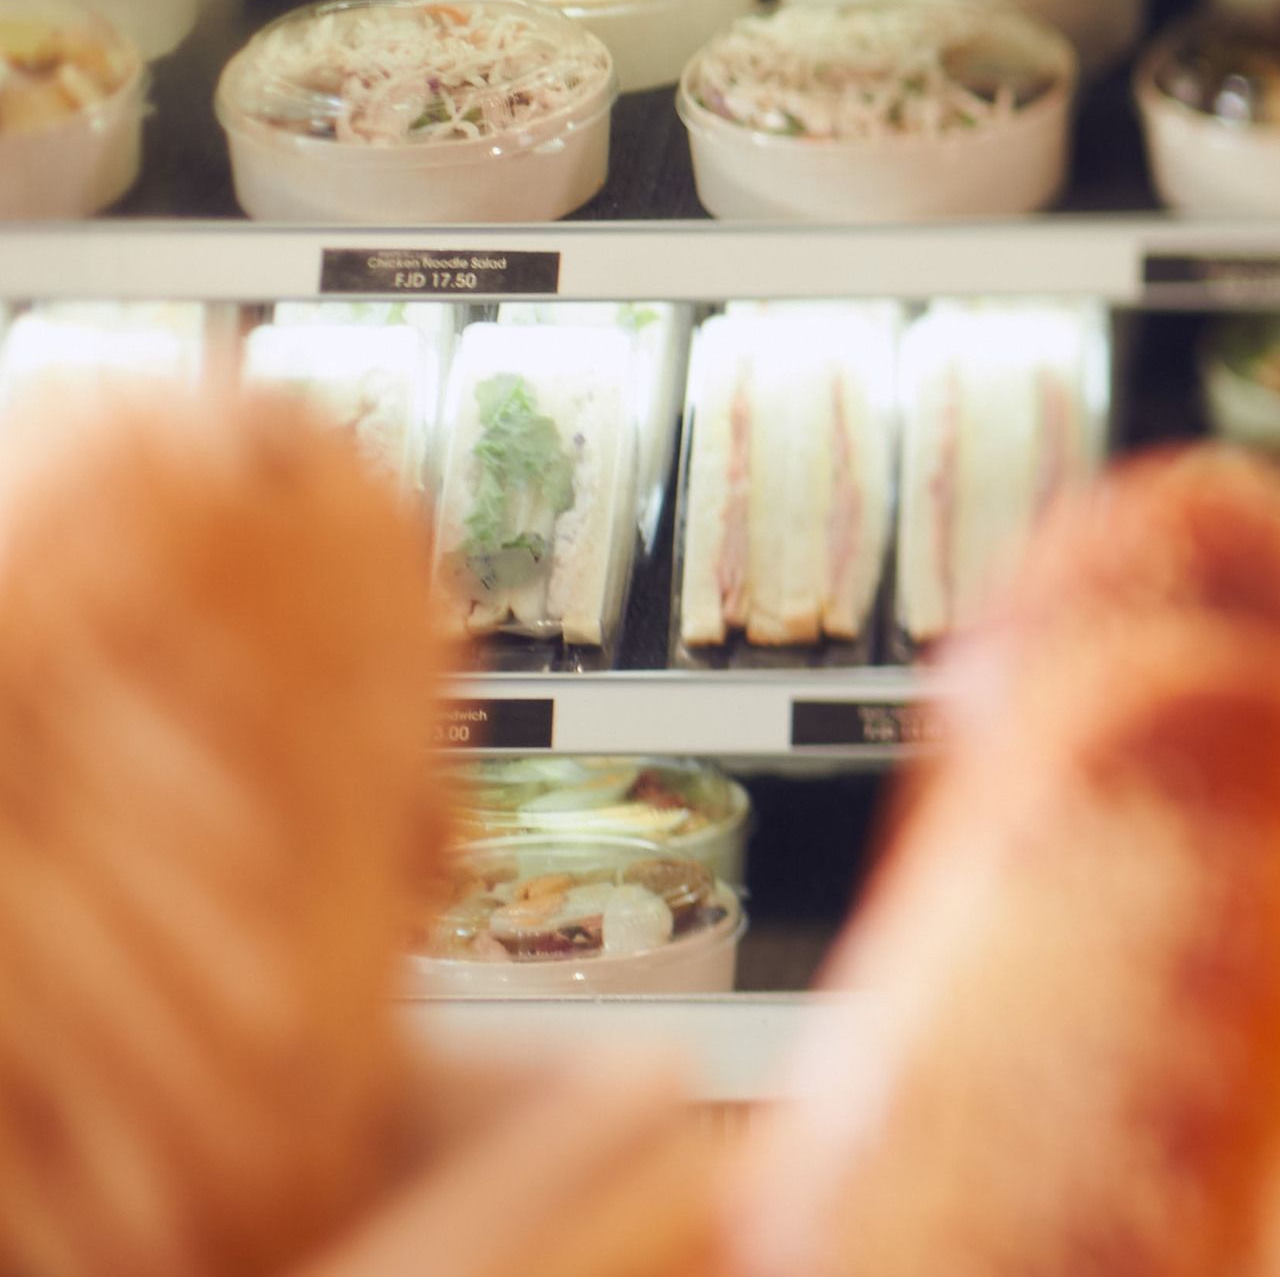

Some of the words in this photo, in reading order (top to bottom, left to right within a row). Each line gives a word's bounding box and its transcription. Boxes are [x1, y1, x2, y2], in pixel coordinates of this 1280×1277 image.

[367, 256, 420, 269] Chicken
[422, 256, 469, 270] Noodle
[470, 257, 507, 270] Salad
[394, 272, 426, 288] FJD
[431, 272, 478, 289] 17.50
